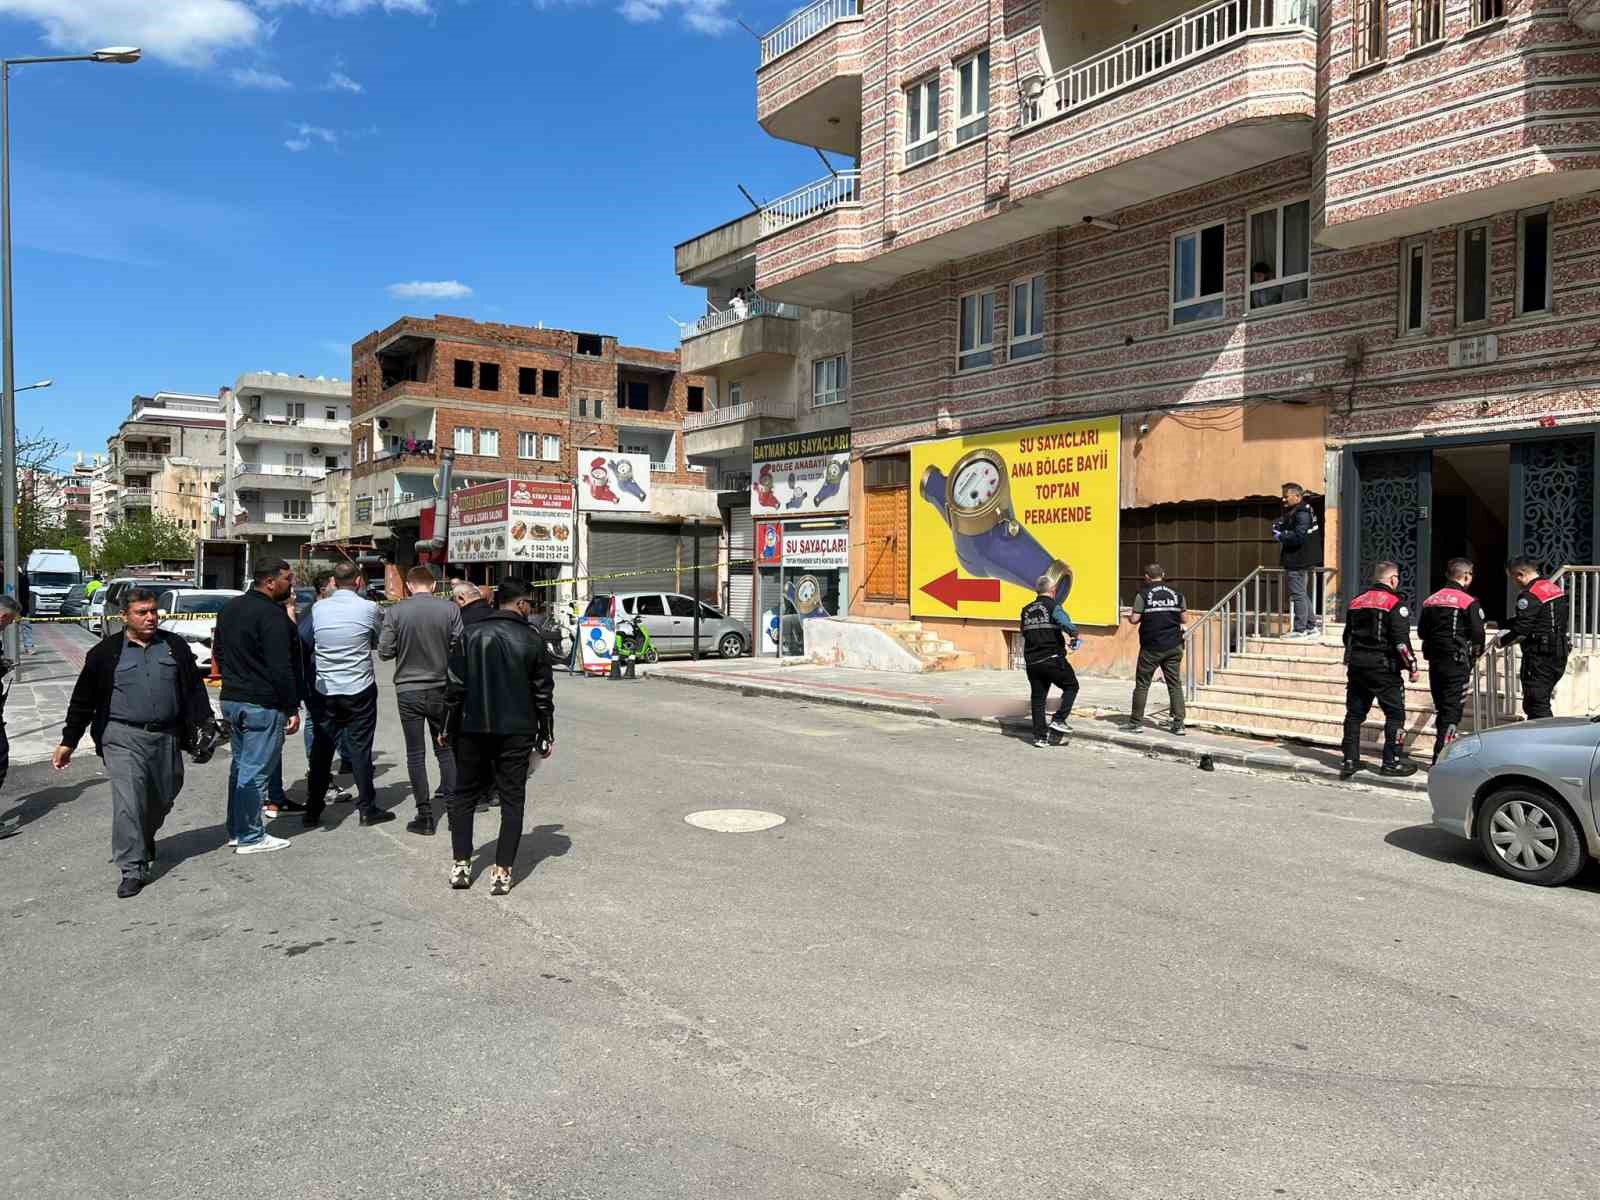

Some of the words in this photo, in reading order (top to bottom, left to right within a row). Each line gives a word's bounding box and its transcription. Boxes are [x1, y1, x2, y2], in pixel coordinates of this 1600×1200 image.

[753, 443, 786, 460] BATMAN
[787, 440, 800, 456] SU
[800, 433, 849, 454] SAYAÇLARI
[1019, 437, 1034, 454] SU
[1037, 429, 1099, 452] SAYACLARI
[1011, 462, 1033, 478] ANA
[1036, 456, 1073, 476] BÖLGE
[1077, 449, 1108, 472] BAYİİ
[1036, 481, 1080, 500] TOPTAN
[1024, 506, 1092, 525] PERAKENDE
[786, 539, 798, 554] SU
[799, 538, 847, 556] SAYAÇLARI
